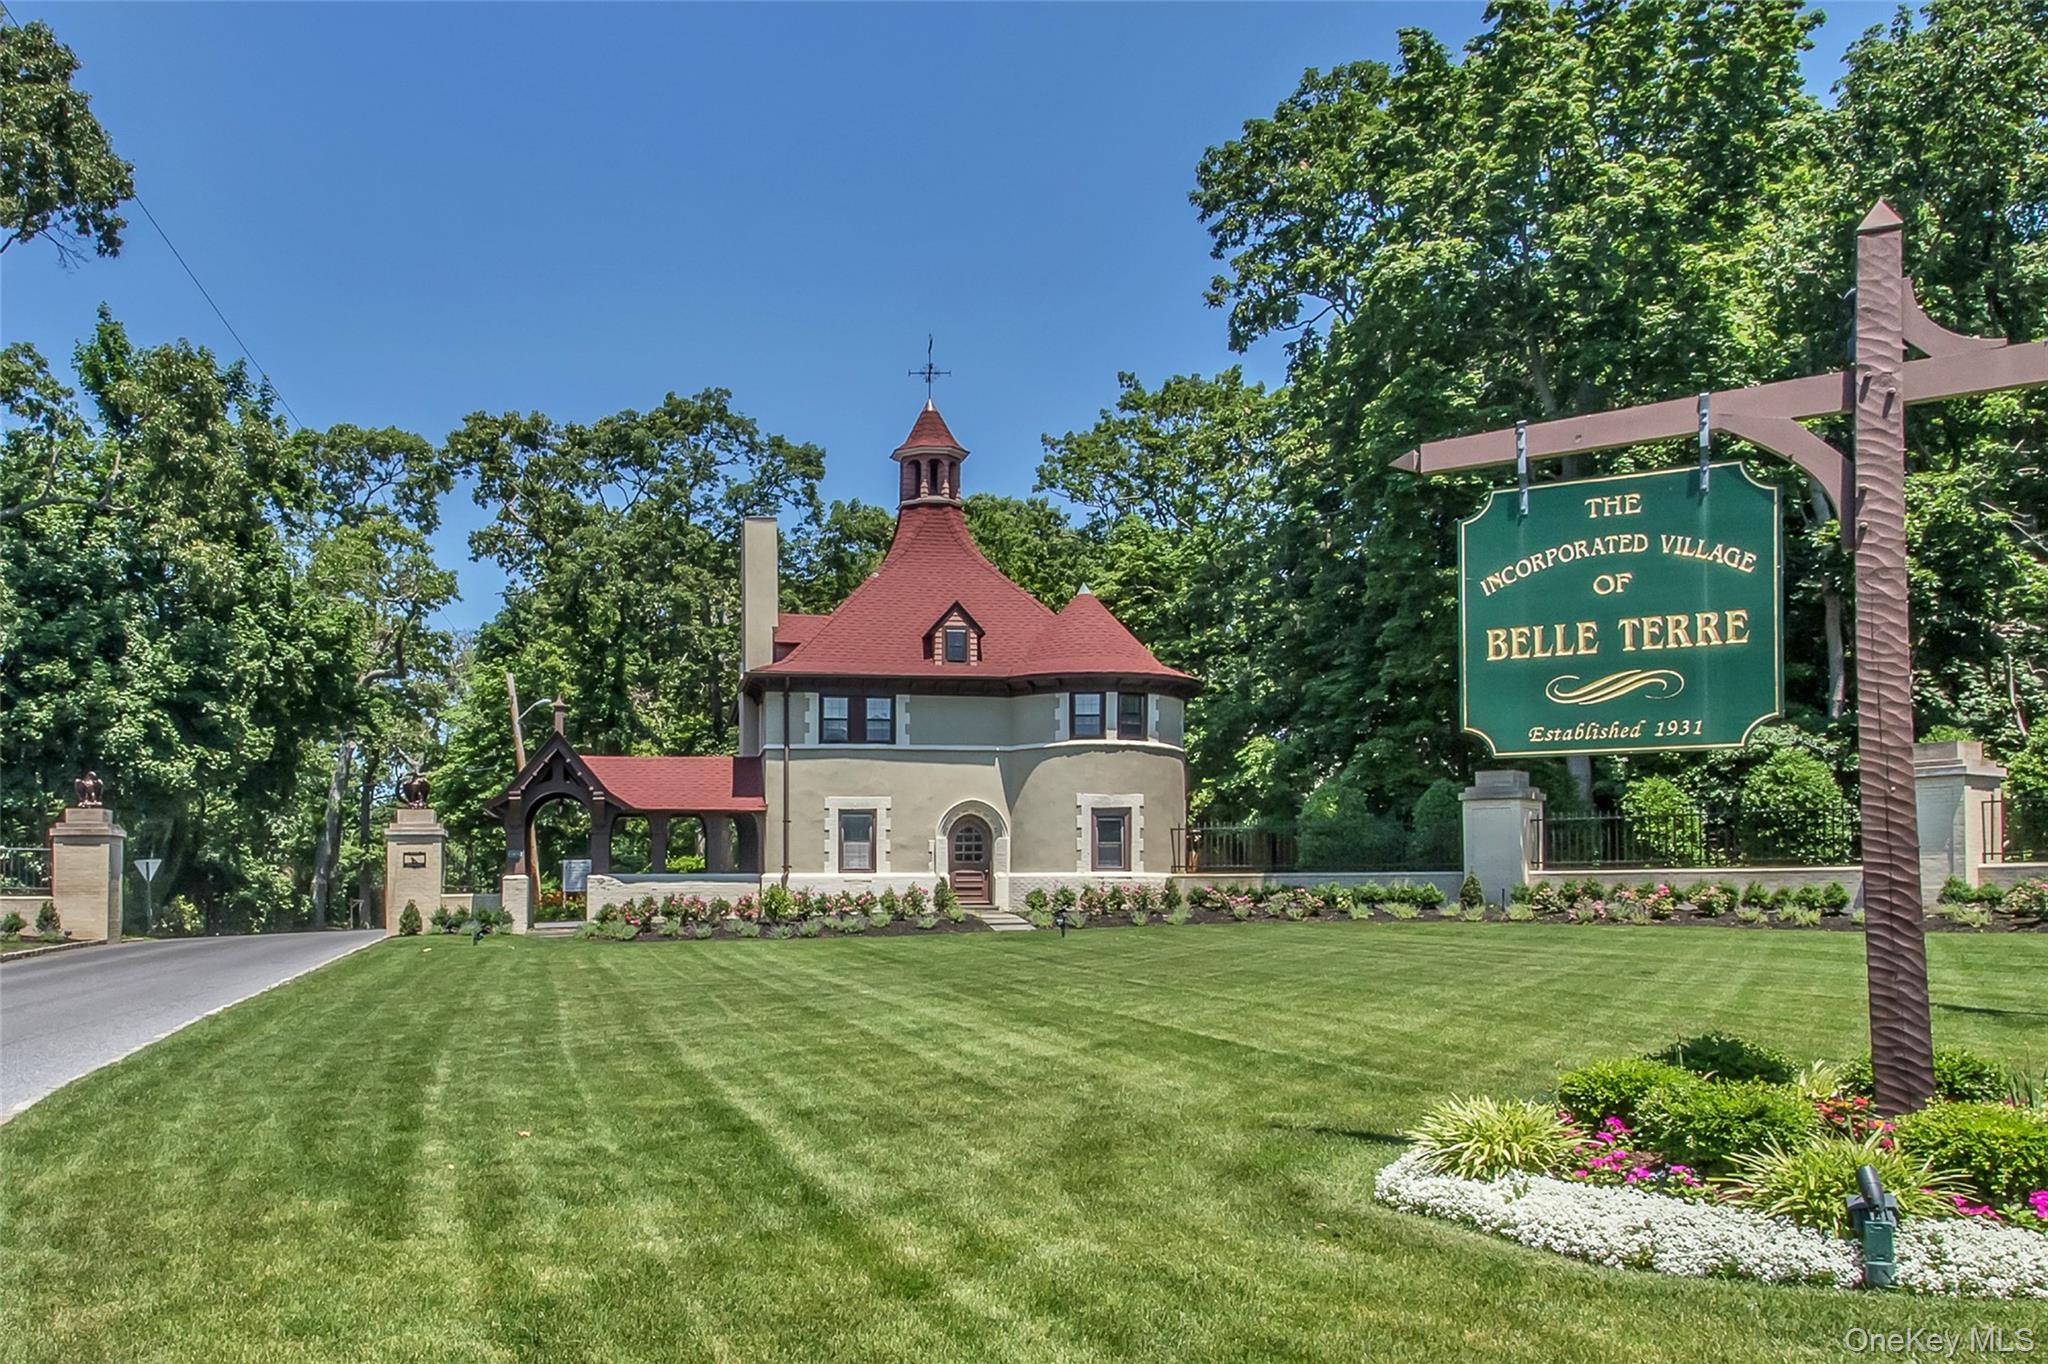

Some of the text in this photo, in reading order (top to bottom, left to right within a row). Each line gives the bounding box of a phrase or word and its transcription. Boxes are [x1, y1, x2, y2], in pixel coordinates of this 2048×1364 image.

[1585, 493, 1642, 519] THE
[1480, 533, 1757, 596] INCORPORATED VILLAGE
[1593, 572, 1633, 595] OF
[1486, 609, 1750, 661] BELLE TERRE
[1528, 719, 1703, 742] Established 1931
